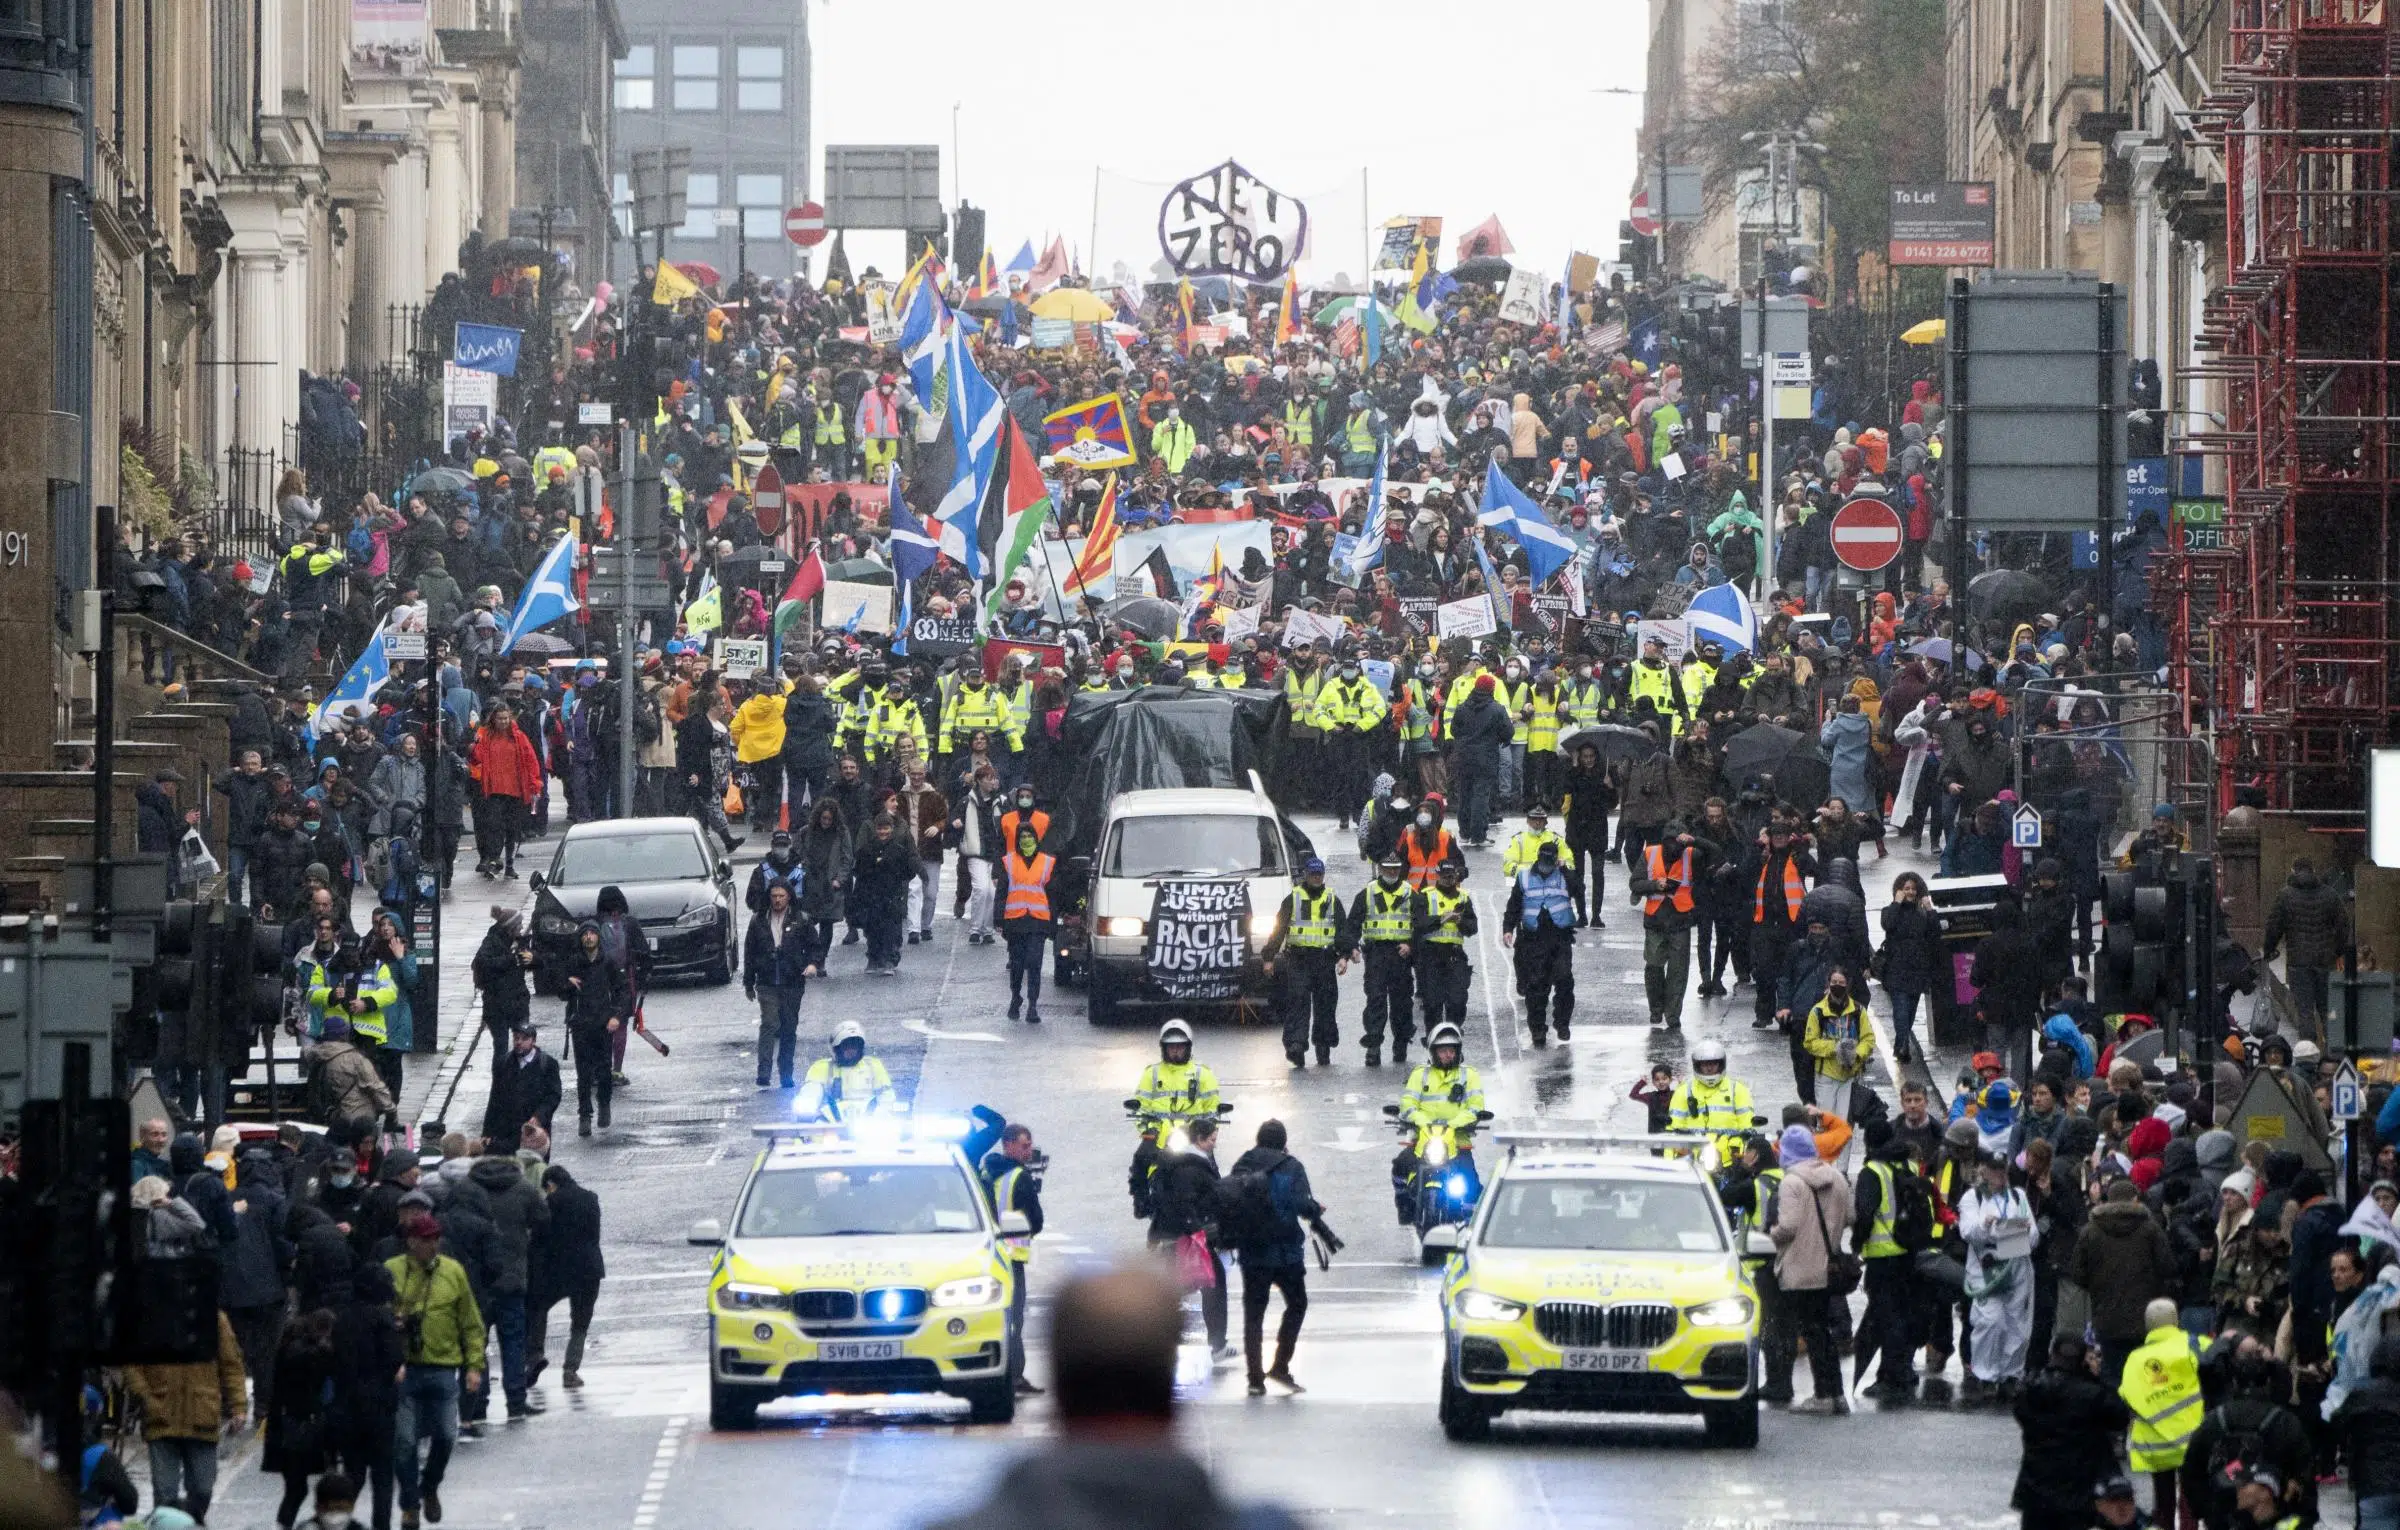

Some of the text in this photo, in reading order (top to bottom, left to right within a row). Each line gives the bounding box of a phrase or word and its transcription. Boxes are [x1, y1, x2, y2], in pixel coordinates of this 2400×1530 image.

[1180, 168, 1278, 224] NET
[1895, 190, 1936, 204] To Let
[1169, 226, 1283, 282] ZERO
[1905, 246, 1988, 257] 0141 226 6777
[1776, 370, 1807, 379] Bus Stop
[2126, 464, 2148, 484] et
[2178, 504, 2206, 521] TO
[727, 648, 758, 660] STOP
[2020, 823, 2035, 843] P
[1161, 892, 1244, 911] JUSTICE
[1177, 911, 1228, 923] without
[1157, 919, 1246, 949] RACIAL
[1148, 944, 1245, 971] JUSTICE
[1178, 974, 1186, 983] is
[1202, 972, 1220, 981] New
[2339, 1086, 2353, 1114] P
[827, 1344, 860, 1359] SV18
[1568, 1353, 1641, 1369] SF20 DPZ
